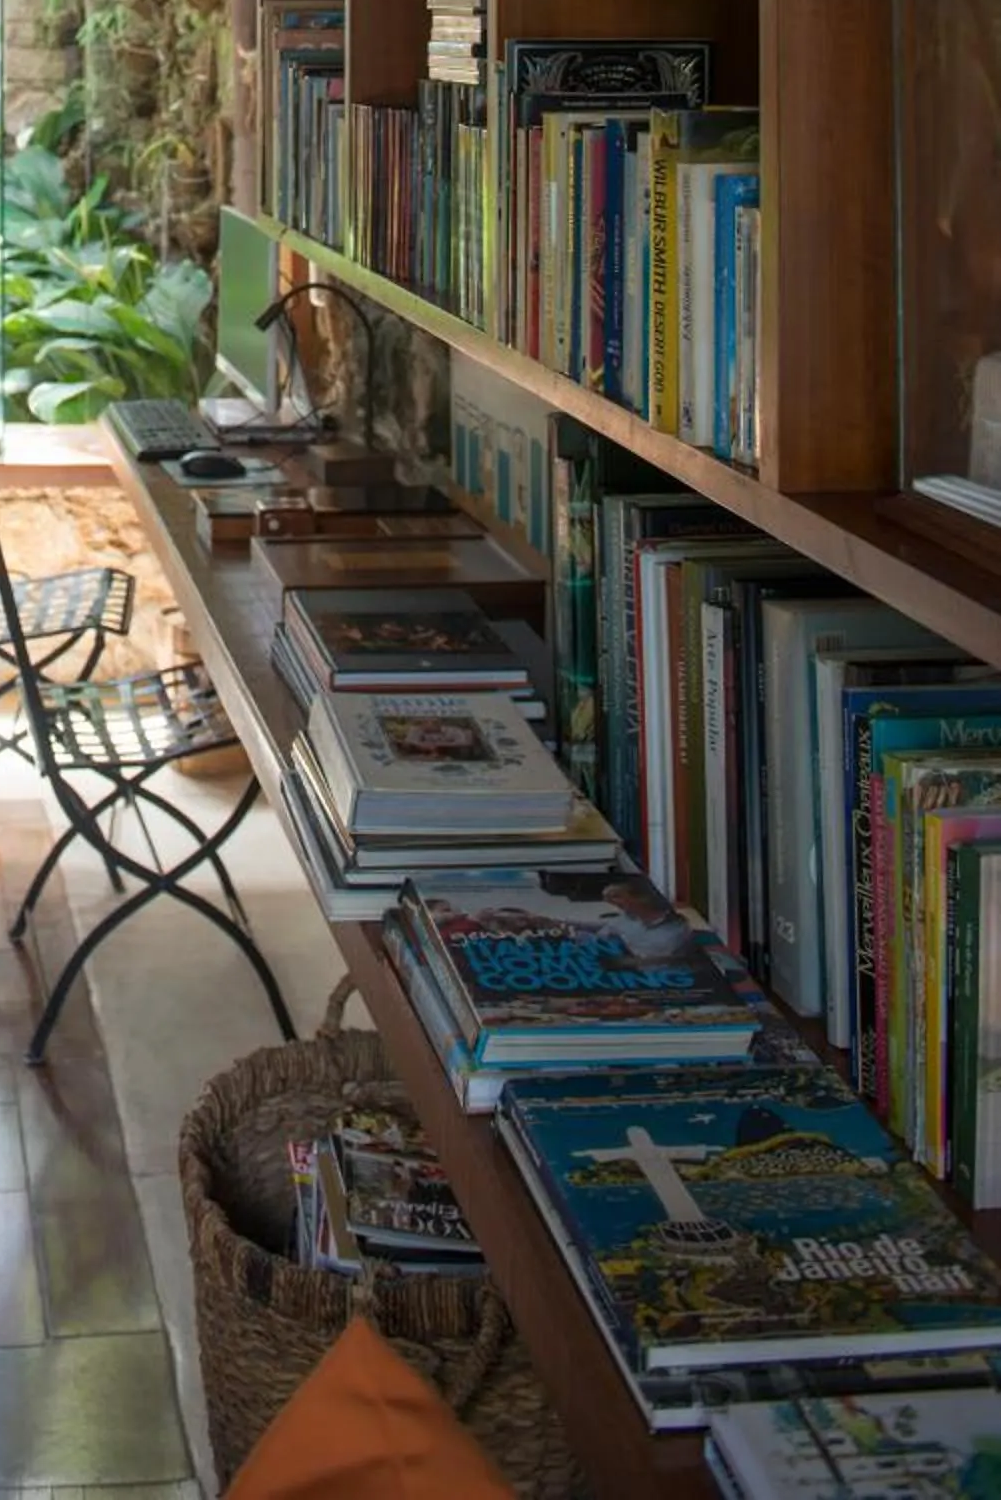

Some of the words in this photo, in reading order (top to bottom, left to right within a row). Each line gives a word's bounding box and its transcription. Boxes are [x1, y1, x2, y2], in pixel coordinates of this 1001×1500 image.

[651, 157, 668, 232] WILBUR
[652, 234, 667, 295] SMITH
[653, 299, 666, 356] DESERT
[652, 359, 666, 394] GOD
[938, 717, 1001, 747] Merv
[463, 934, 626, 961] ITALIAN
[468, 948, 604, 974] HOME
[477, 967, 695, 991] COOKING
[793, 1236, 863, 1261] Rio
[873, 1233, 924, 1257] de
[777, 1254, 929, 1282] Janeiro
